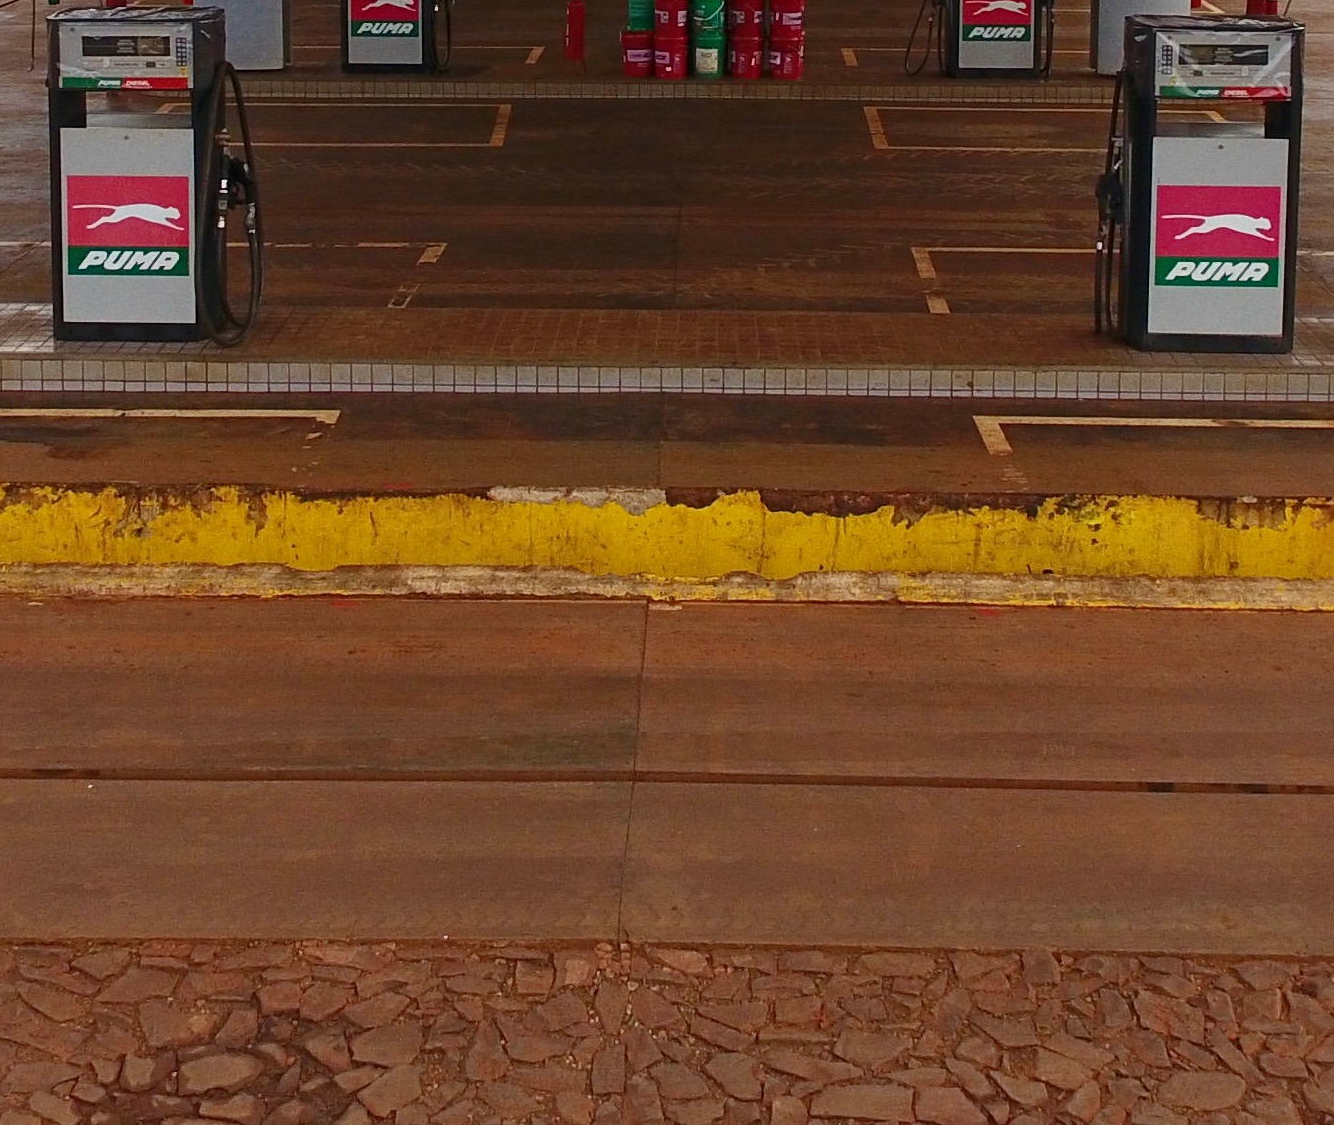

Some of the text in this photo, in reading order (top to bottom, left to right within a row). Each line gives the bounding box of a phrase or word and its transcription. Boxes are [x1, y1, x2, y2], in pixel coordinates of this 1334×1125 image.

[356, 22, 415, 35] PUMA
[967, 26, 1027, 39] PUMA
[77, 249, 181, 271] PUMA
[1165, 260, 1270, 282] PUMA
